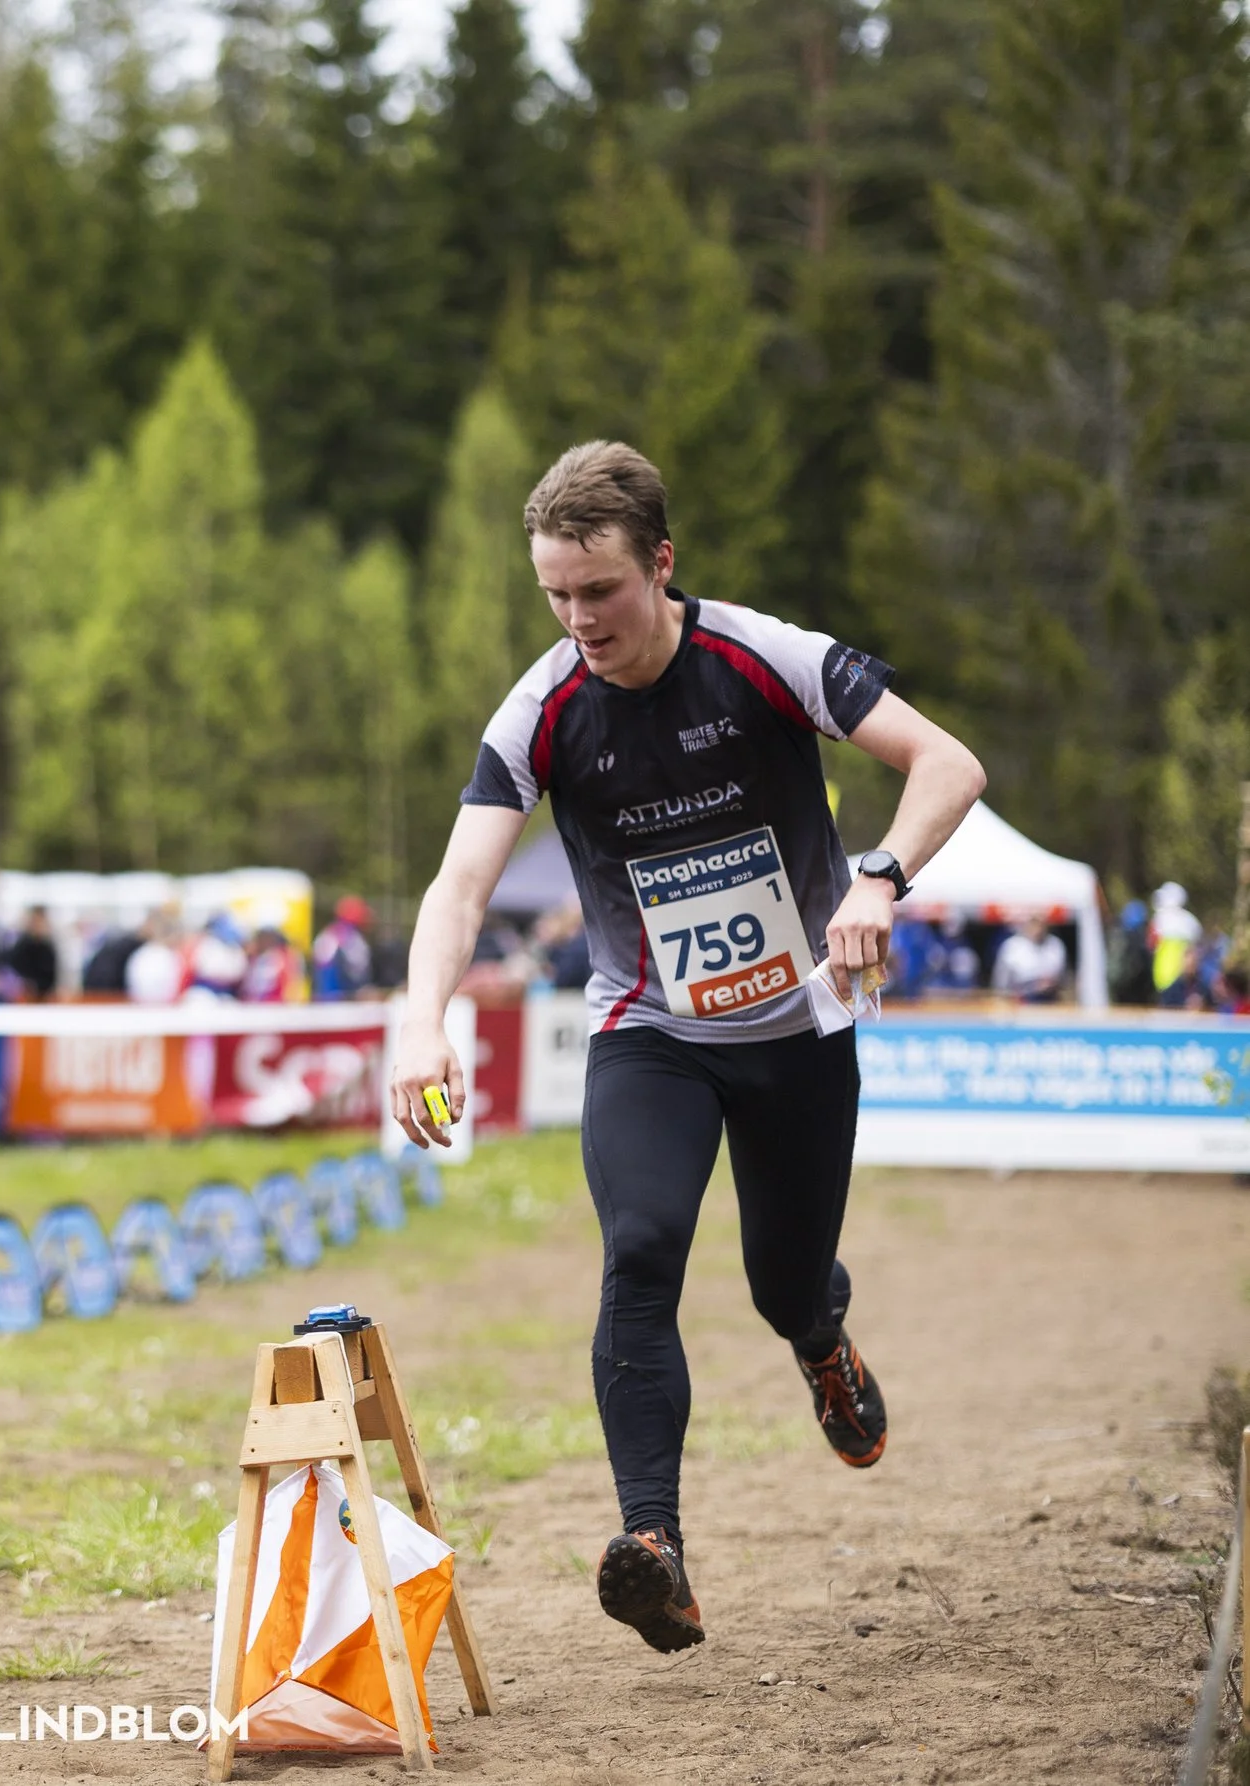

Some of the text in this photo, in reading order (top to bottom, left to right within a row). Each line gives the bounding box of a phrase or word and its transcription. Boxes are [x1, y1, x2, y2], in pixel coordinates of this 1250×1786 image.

[616, 781, 743, 826] ATTUNDA
[635, 839, 772, 889] bagheera
[668, 870, 753, 900] SM STAFETT 2025
[766, 878, 782, 903] 1
[659, 913, 766, 983] 759
[701, 964, 788, 1012] renta
